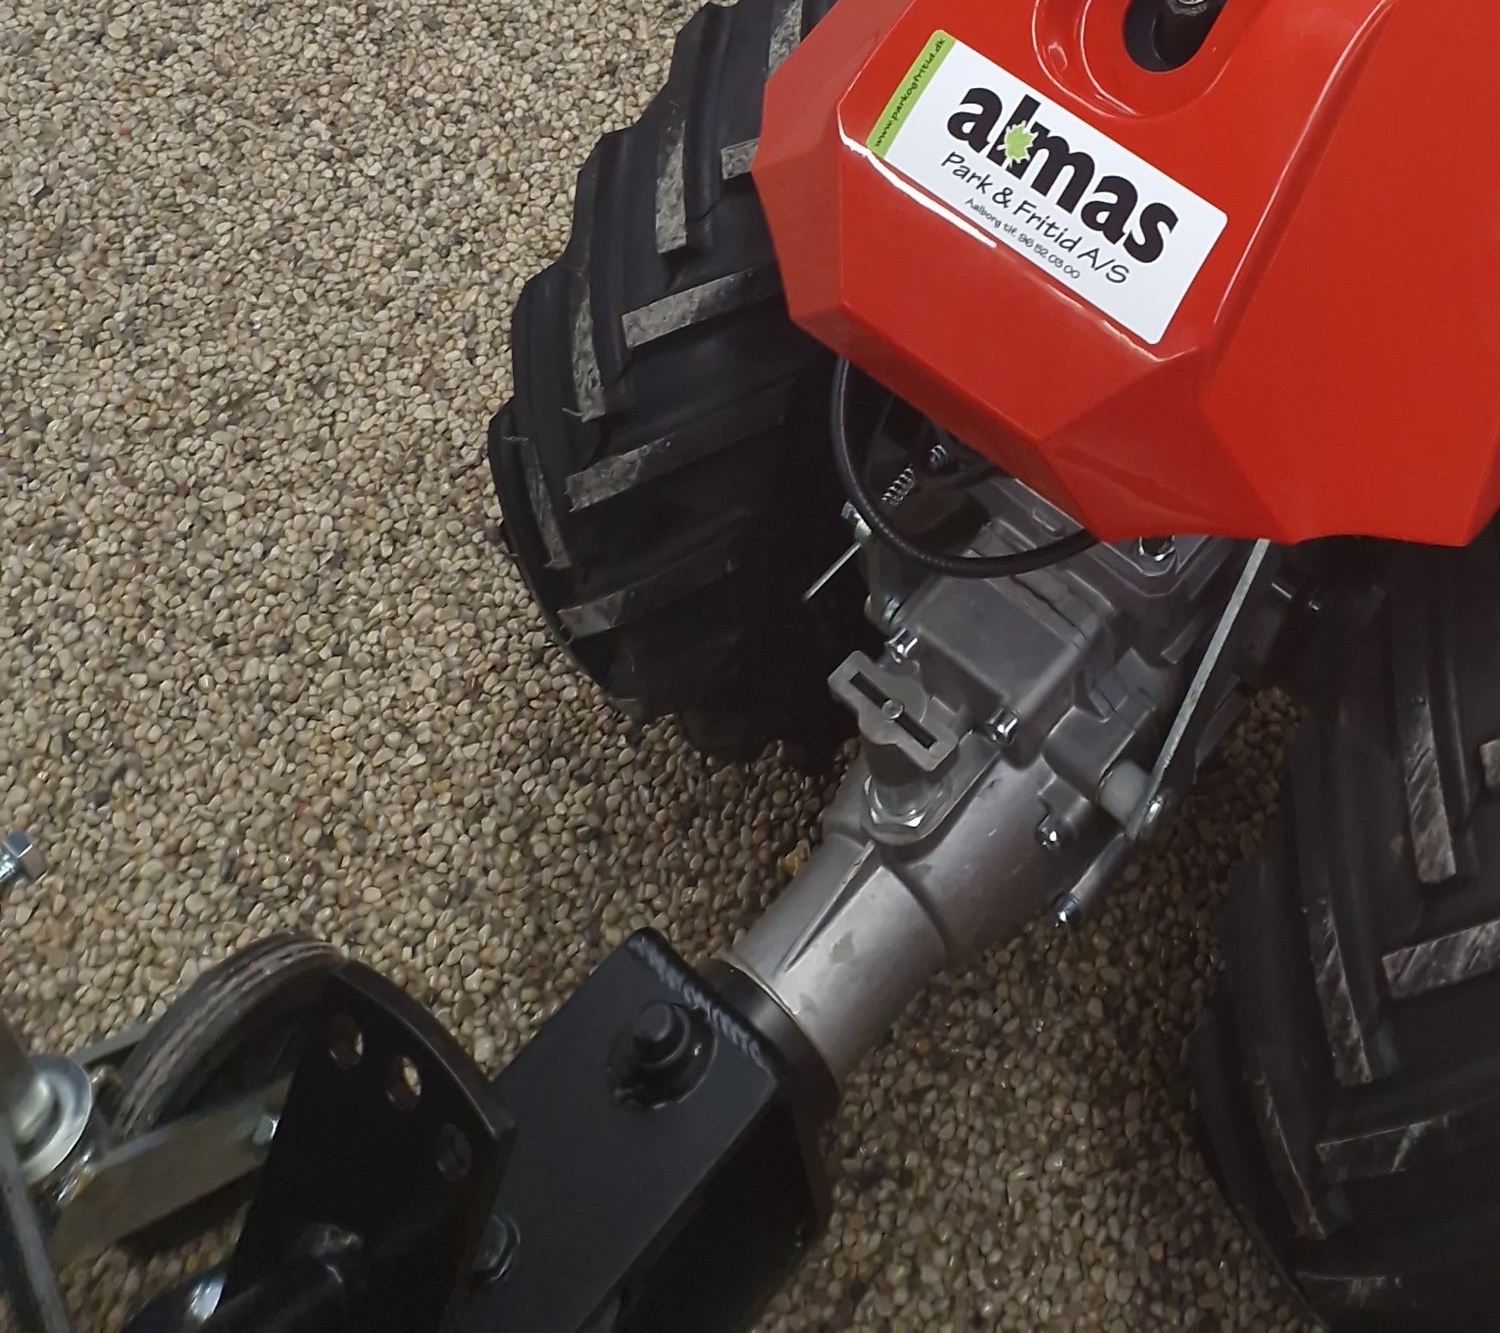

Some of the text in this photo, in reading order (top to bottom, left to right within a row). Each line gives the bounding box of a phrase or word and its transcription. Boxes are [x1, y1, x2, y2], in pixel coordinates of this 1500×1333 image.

[875, 39, 946, 147] www.parkogfritid.dk
[941, 151, 1130, 284] Park & Fritid A/S
[947, 87, 1179, 264] almas
[965, 198, 1080, 279] Aalborg tlf. 96 52 03 00
